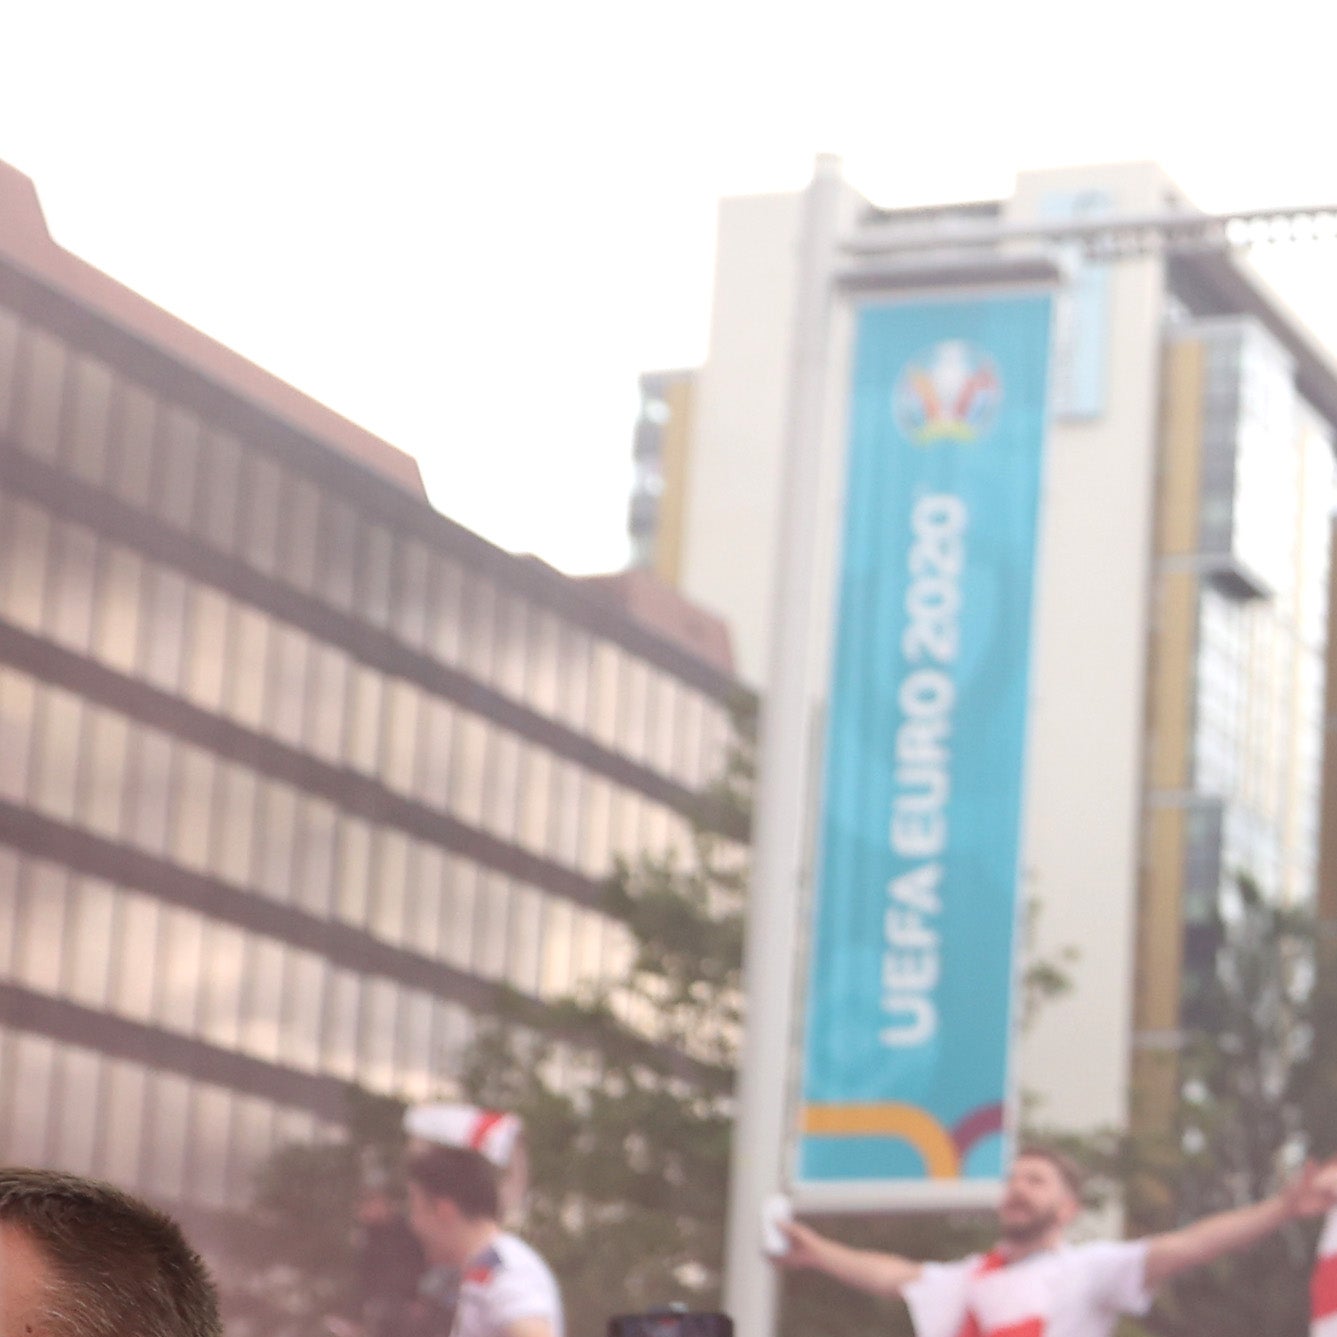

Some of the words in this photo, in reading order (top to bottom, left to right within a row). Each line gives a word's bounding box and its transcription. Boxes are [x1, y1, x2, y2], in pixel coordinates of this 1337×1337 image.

[903, 493, 968, 663] 2020
[891, 668, 956, 858] EURO
[879, 862, 944, 1047] UEFA
